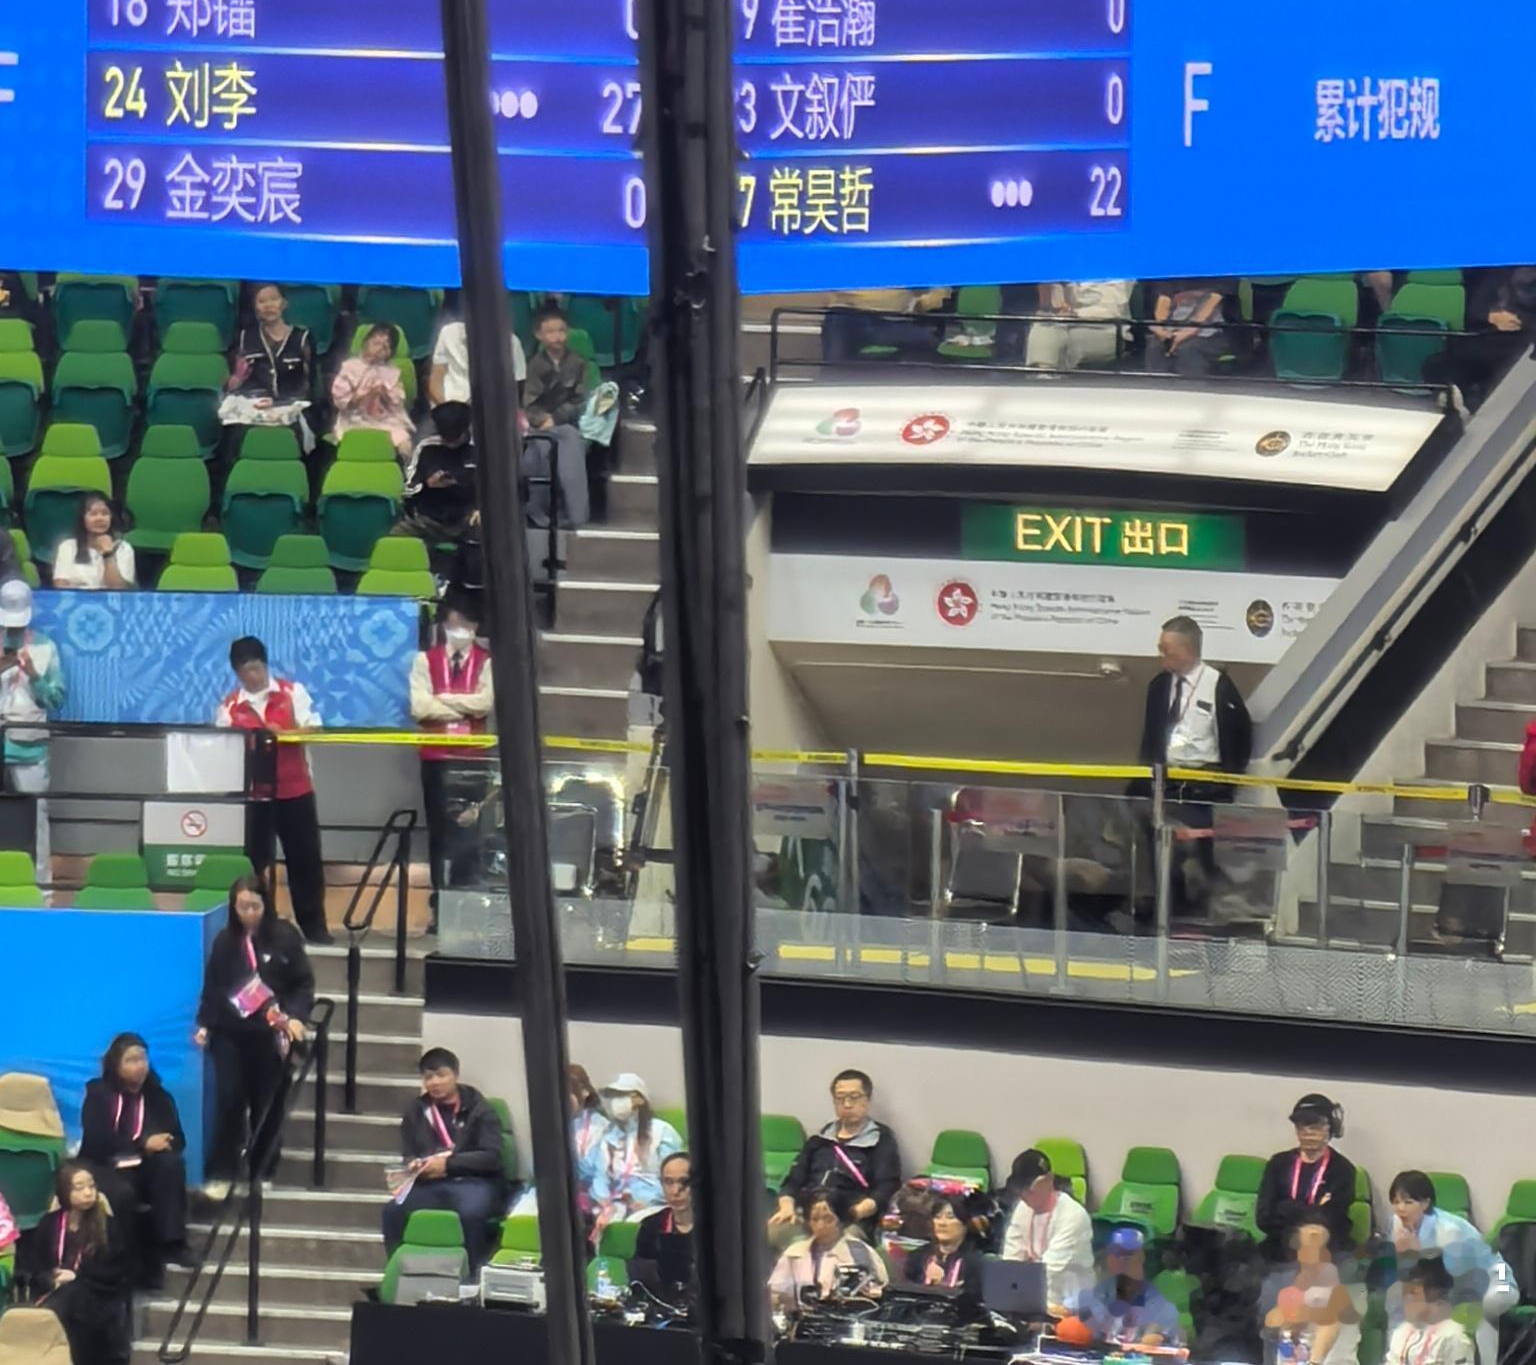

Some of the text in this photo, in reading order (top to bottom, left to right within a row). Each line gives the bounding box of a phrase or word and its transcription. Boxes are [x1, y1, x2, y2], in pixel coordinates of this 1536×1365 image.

[105, 61, 641, 134] 24 刘李 27
[770, 73, 1123, 139] 文叙俨 0
[1184, 62, 1440, 146] F 累计犯规
[104, 153, 646, 228] 29 金奕宸 0
[770, 166, 1121, 234] 常昊哲 22
[1017, 514, 1188, 555] EXIT 出口
